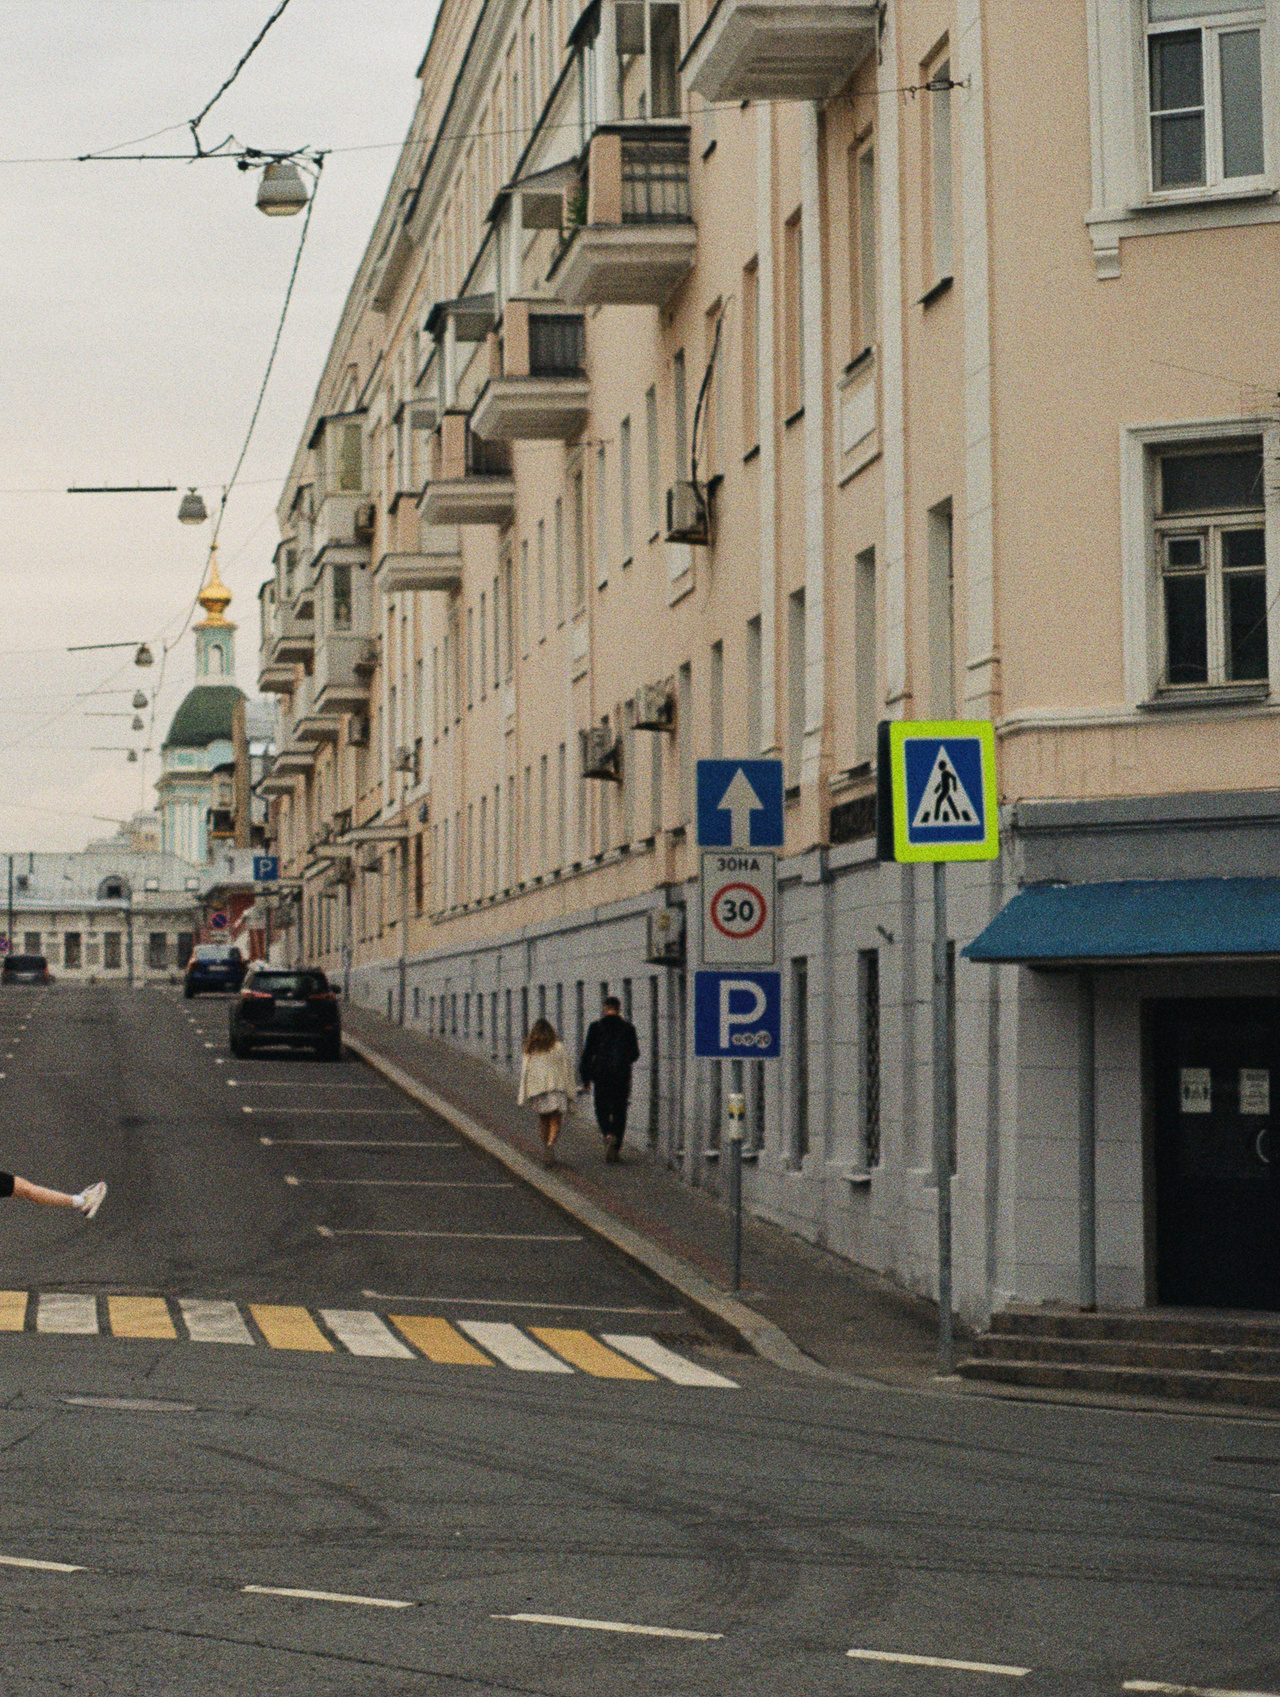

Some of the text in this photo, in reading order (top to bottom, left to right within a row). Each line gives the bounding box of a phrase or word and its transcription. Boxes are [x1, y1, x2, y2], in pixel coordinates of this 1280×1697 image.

[259, 860, 273, 877] P
[717, 857, 760, 872] ЗОНА
[723, 899, 754, 922] 30
[720, 980, 766, 1048] P
